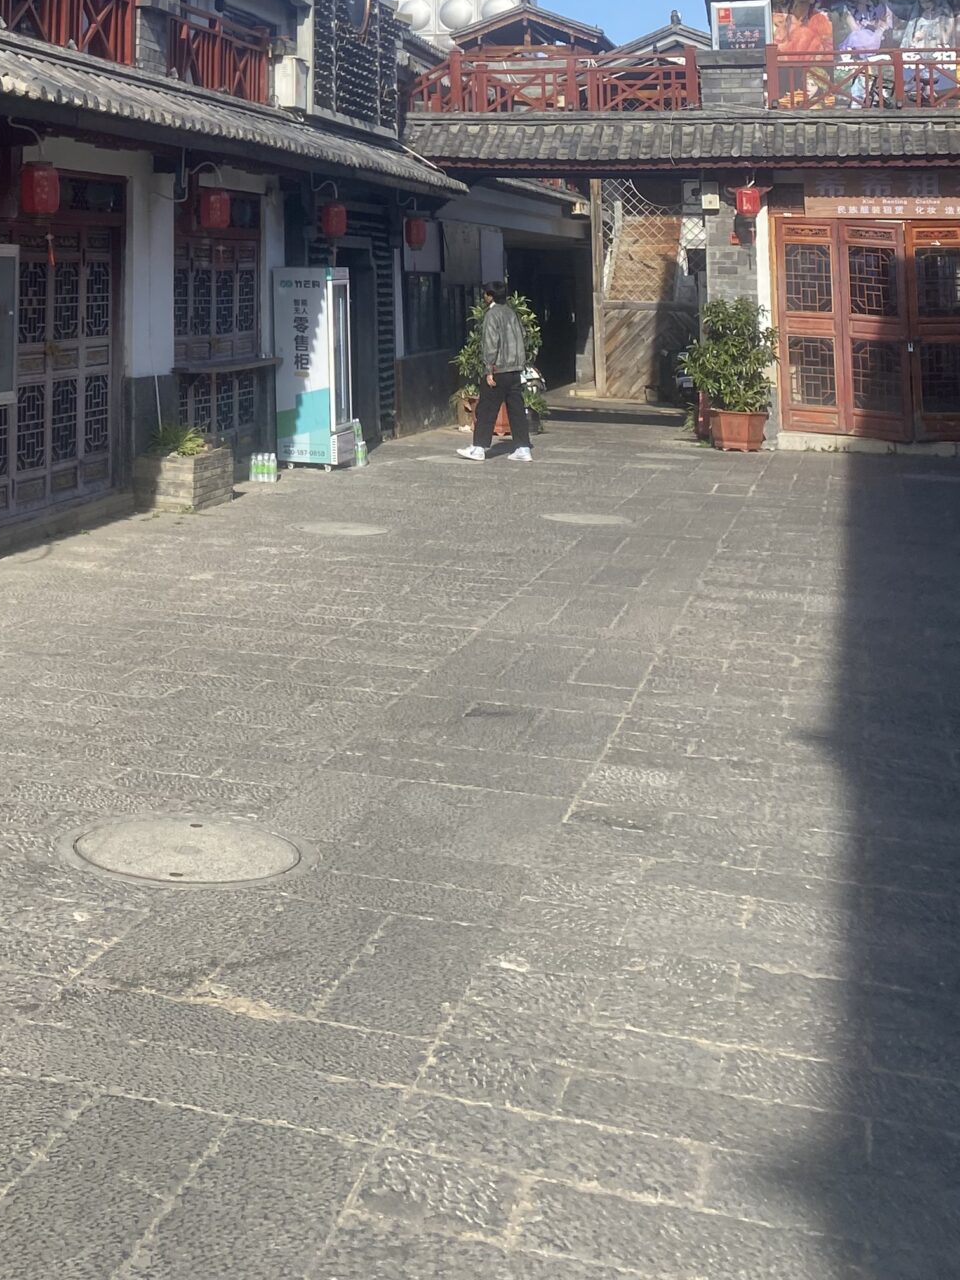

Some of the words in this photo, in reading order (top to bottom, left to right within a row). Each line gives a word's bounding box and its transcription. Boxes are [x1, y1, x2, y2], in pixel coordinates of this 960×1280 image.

[815, 172, 960, 197] 希希租
[914, 205, 937, 215] 化妆
[293, 307, 308, 315] 无人
[293, 316, 310, 370] 零售柜
